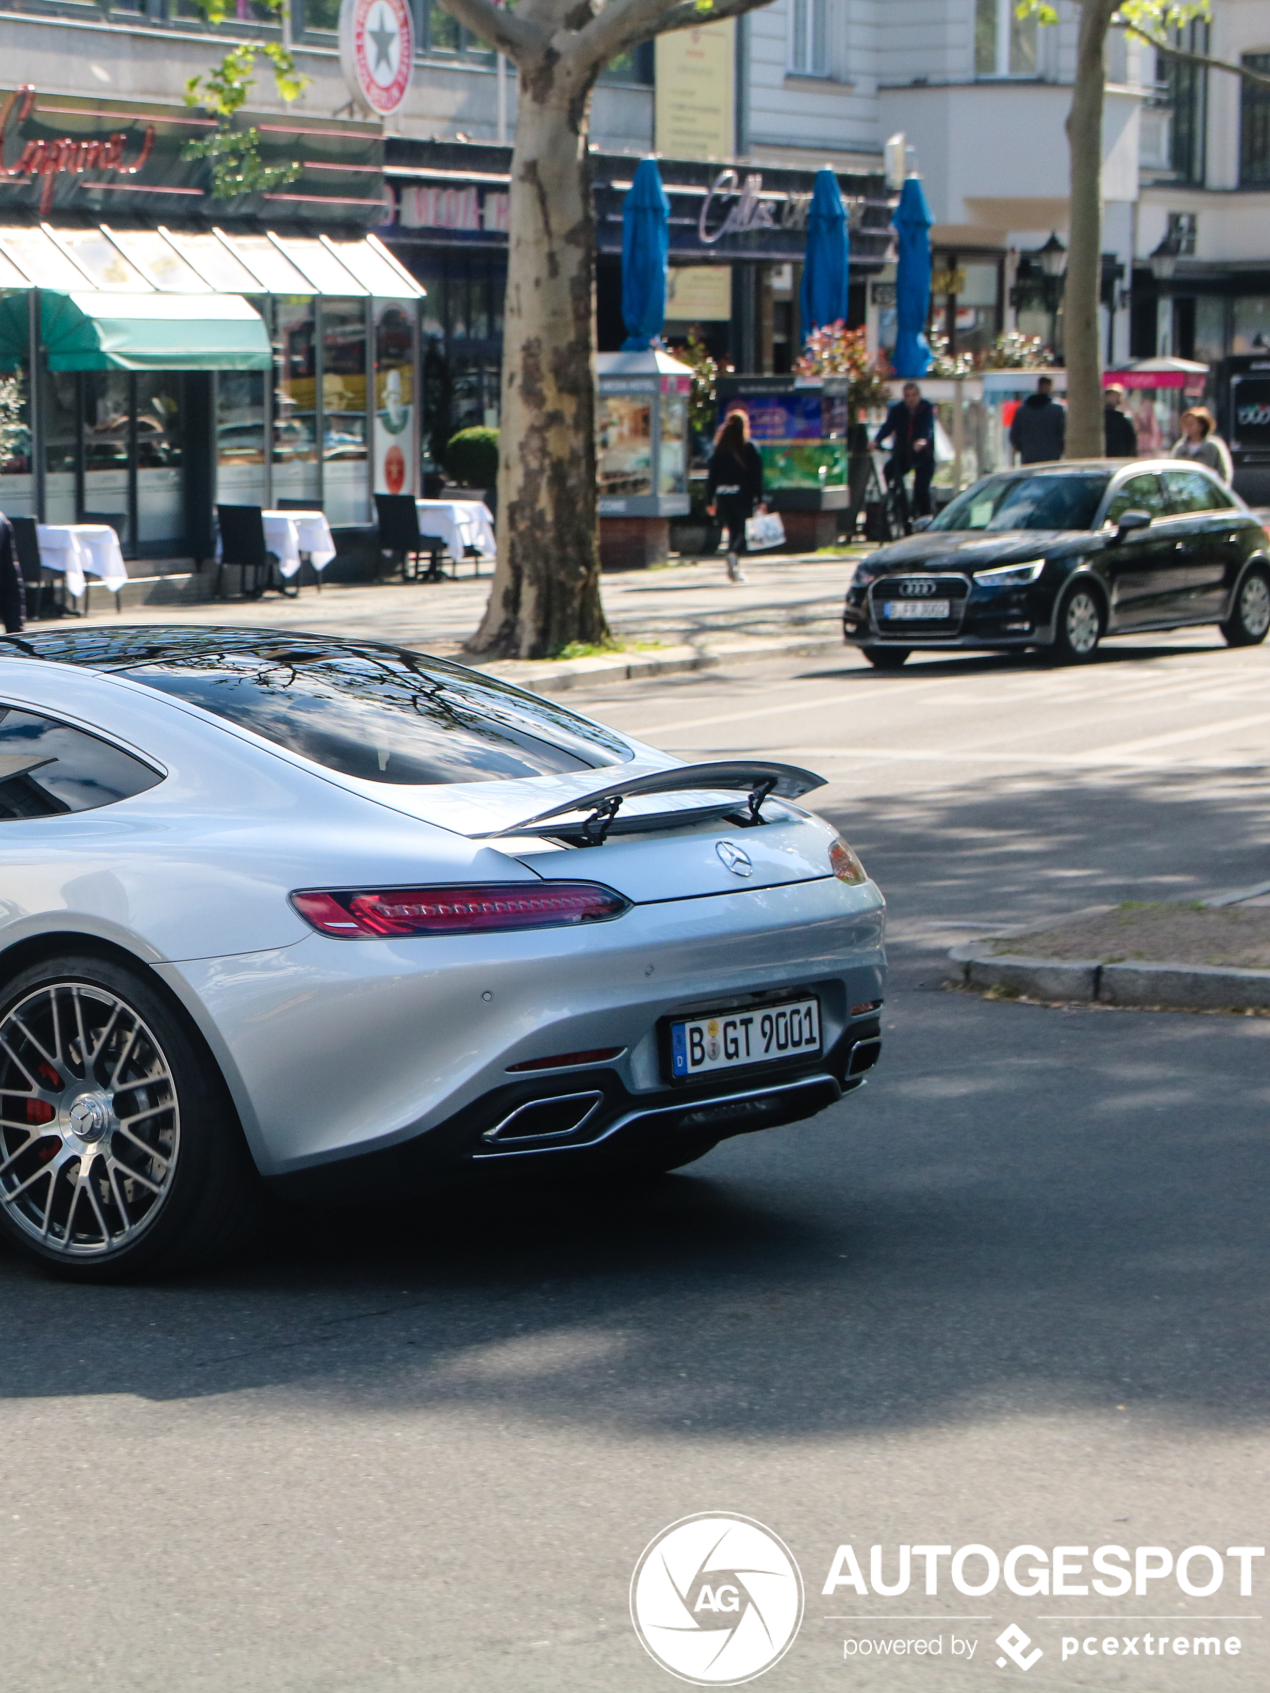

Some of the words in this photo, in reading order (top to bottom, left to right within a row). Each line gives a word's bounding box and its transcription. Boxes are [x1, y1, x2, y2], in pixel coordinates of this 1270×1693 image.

[689, 1026, 706, 1067] B
[723, 1017, 754, 1060] GT
[760, 1006, 817, 1054] 9001
